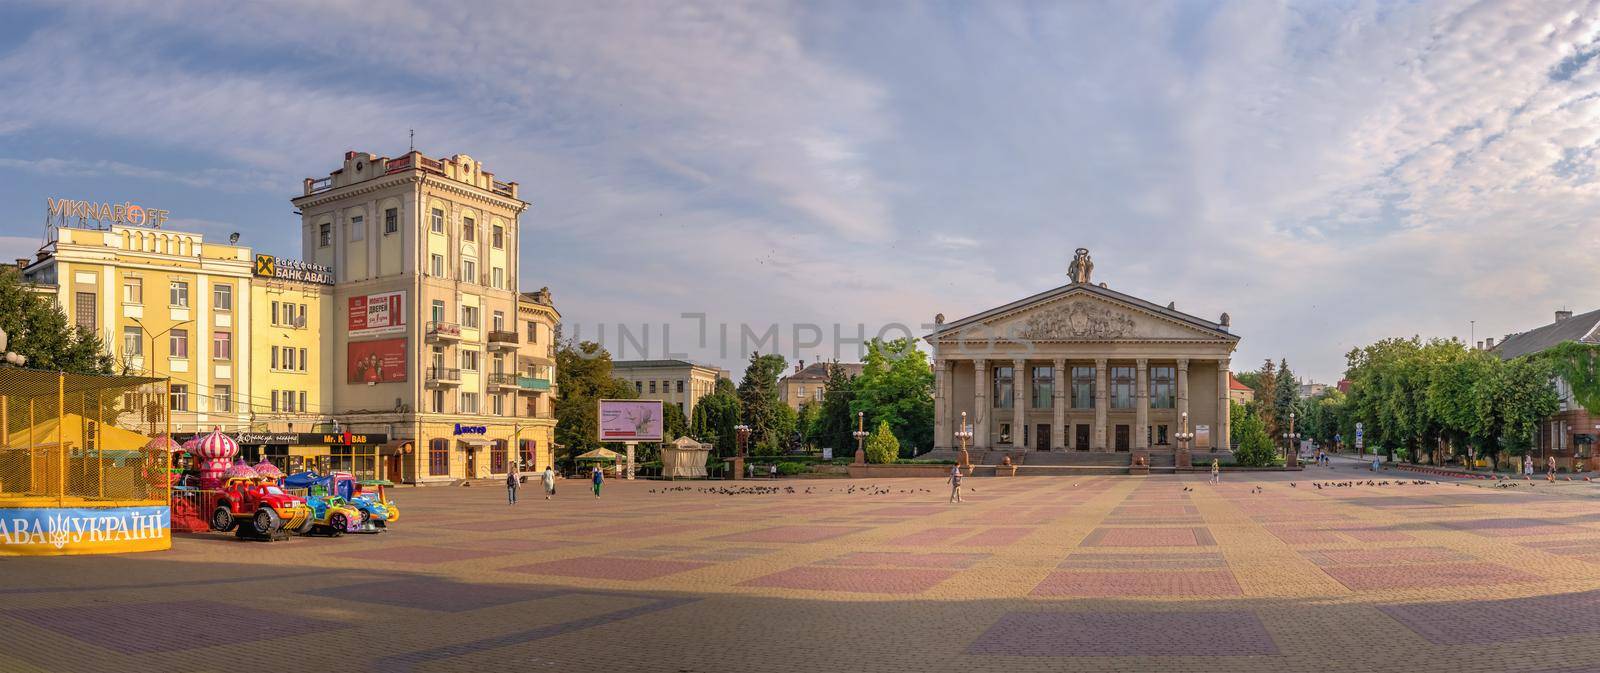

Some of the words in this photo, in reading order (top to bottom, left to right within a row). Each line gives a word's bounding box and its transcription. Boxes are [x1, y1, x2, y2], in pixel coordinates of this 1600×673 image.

[276, 268, 302, 280] БАНК
[304, 272, 335, 285] АВАЛЬ
[323, 435, 336, 443] Mr.
[72, 510, 165, 542] УКРАЇНІ
